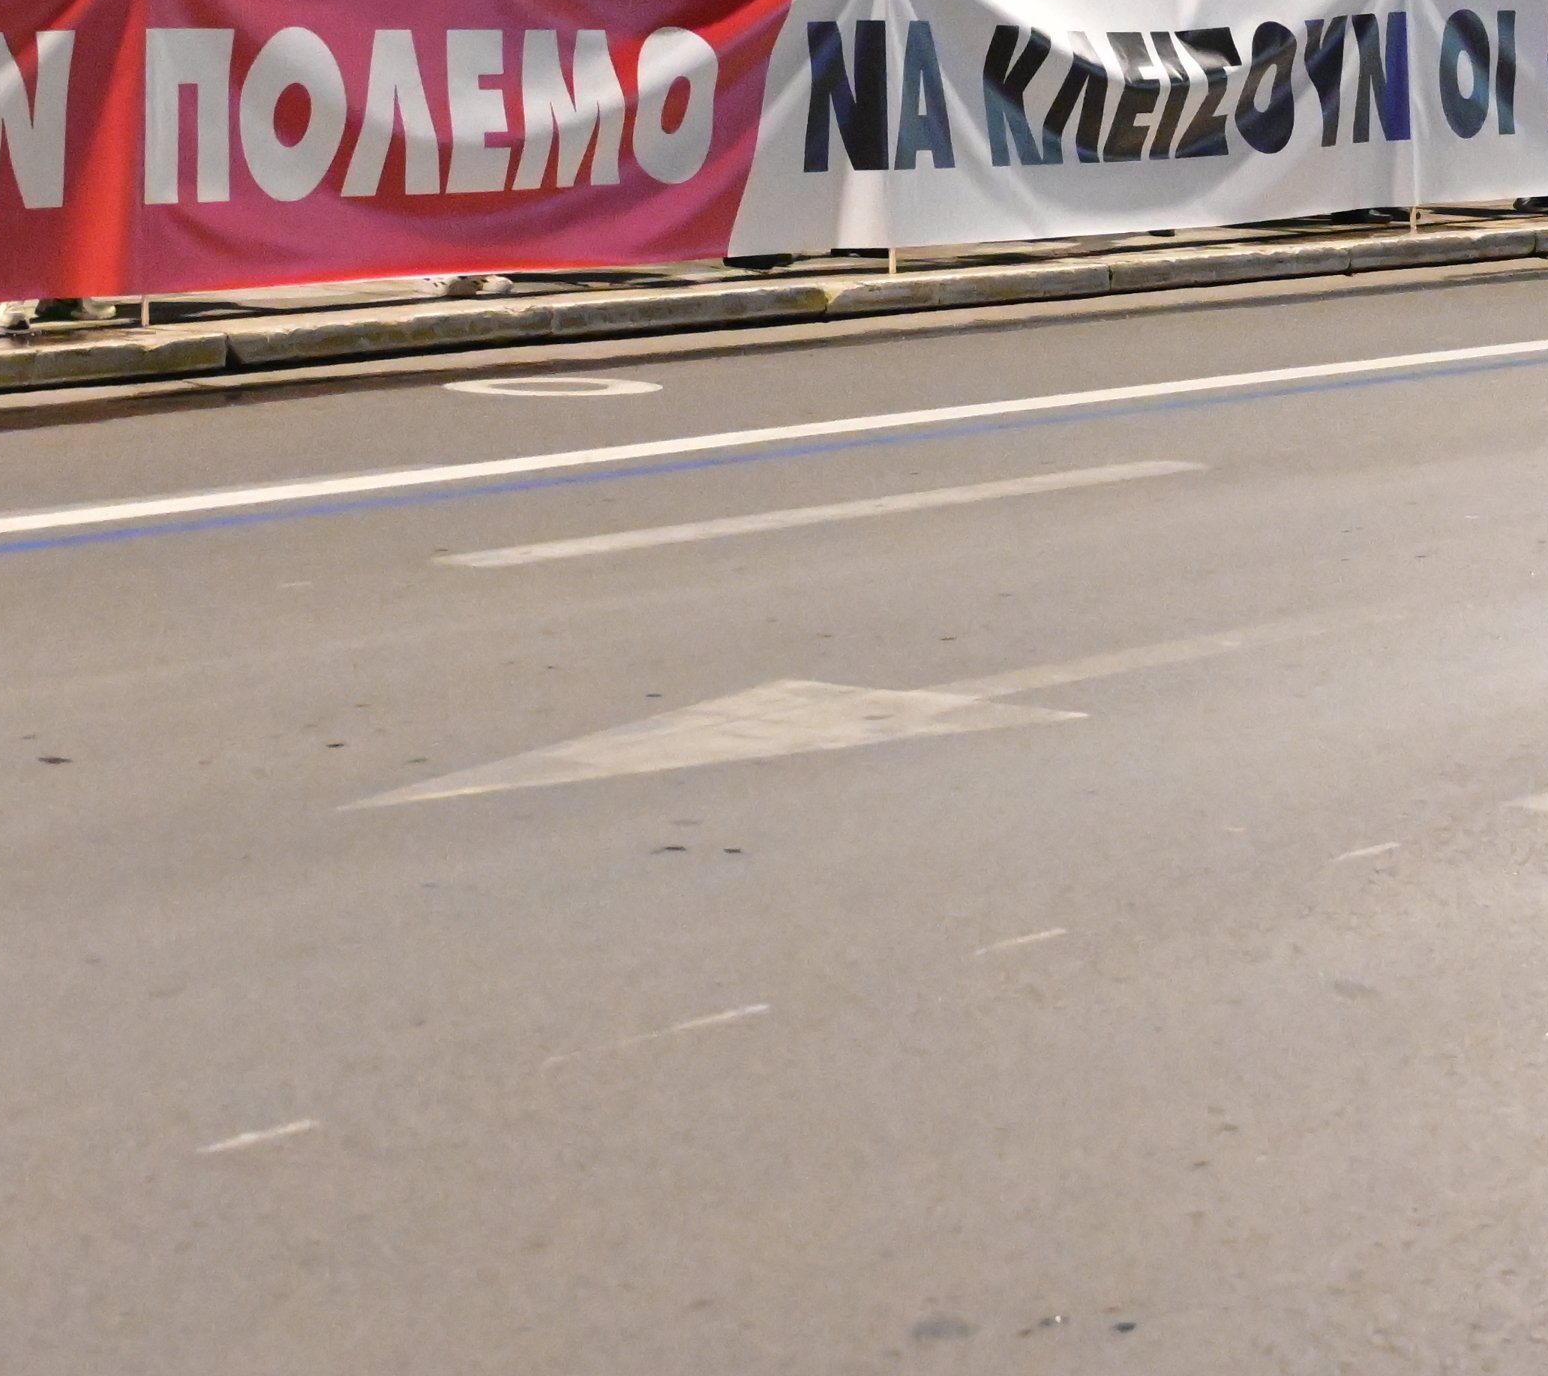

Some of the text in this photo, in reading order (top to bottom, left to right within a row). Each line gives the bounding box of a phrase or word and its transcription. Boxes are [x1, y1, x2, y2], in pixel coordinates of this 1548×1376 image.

[144, 26, 718, 205] ΠΟΛΕΜΟ
[804, 20, 956, 173] ΝΑ
[983, 11, 1412, 167] ΚΛΕΙΣΟΥΝ
[1439, 8, 1517, 140] ΟΙ
